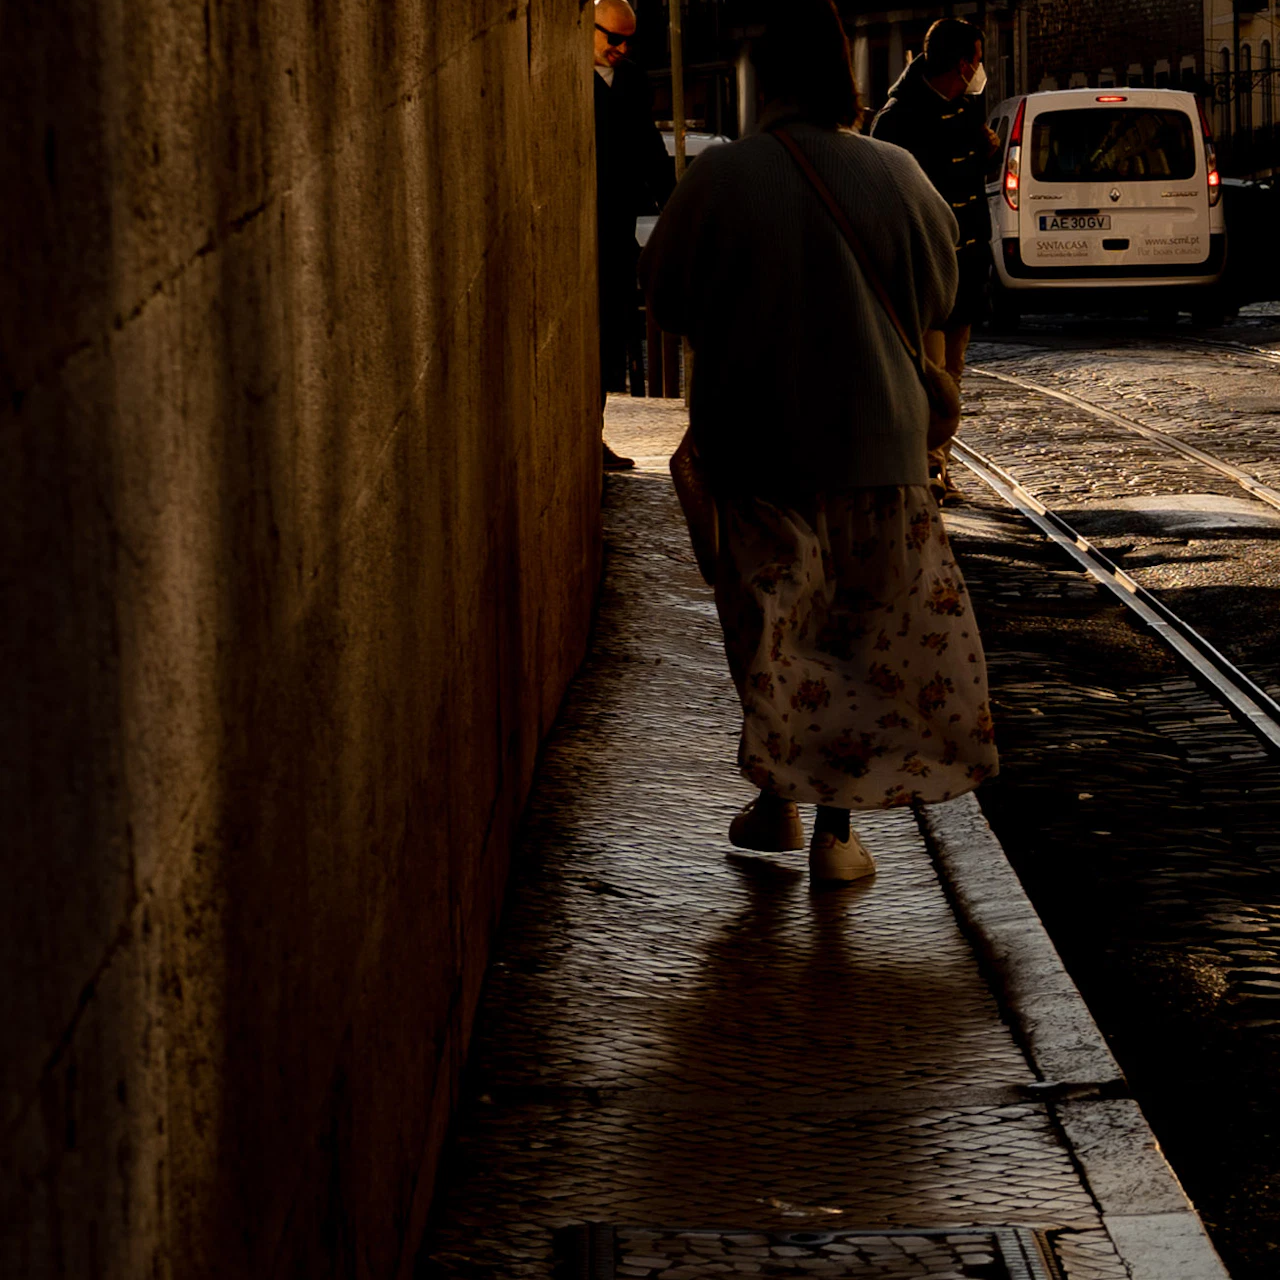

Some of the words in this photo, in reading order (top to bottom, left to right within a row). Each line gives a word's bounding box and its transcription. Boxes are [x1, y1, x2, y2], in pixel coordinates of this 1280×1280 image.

[1036, 241, 1064, 250] SANTA
[1065, 241, 1088, 250] CASA
[1144, 236, 1200, 246] www.scml.pt
